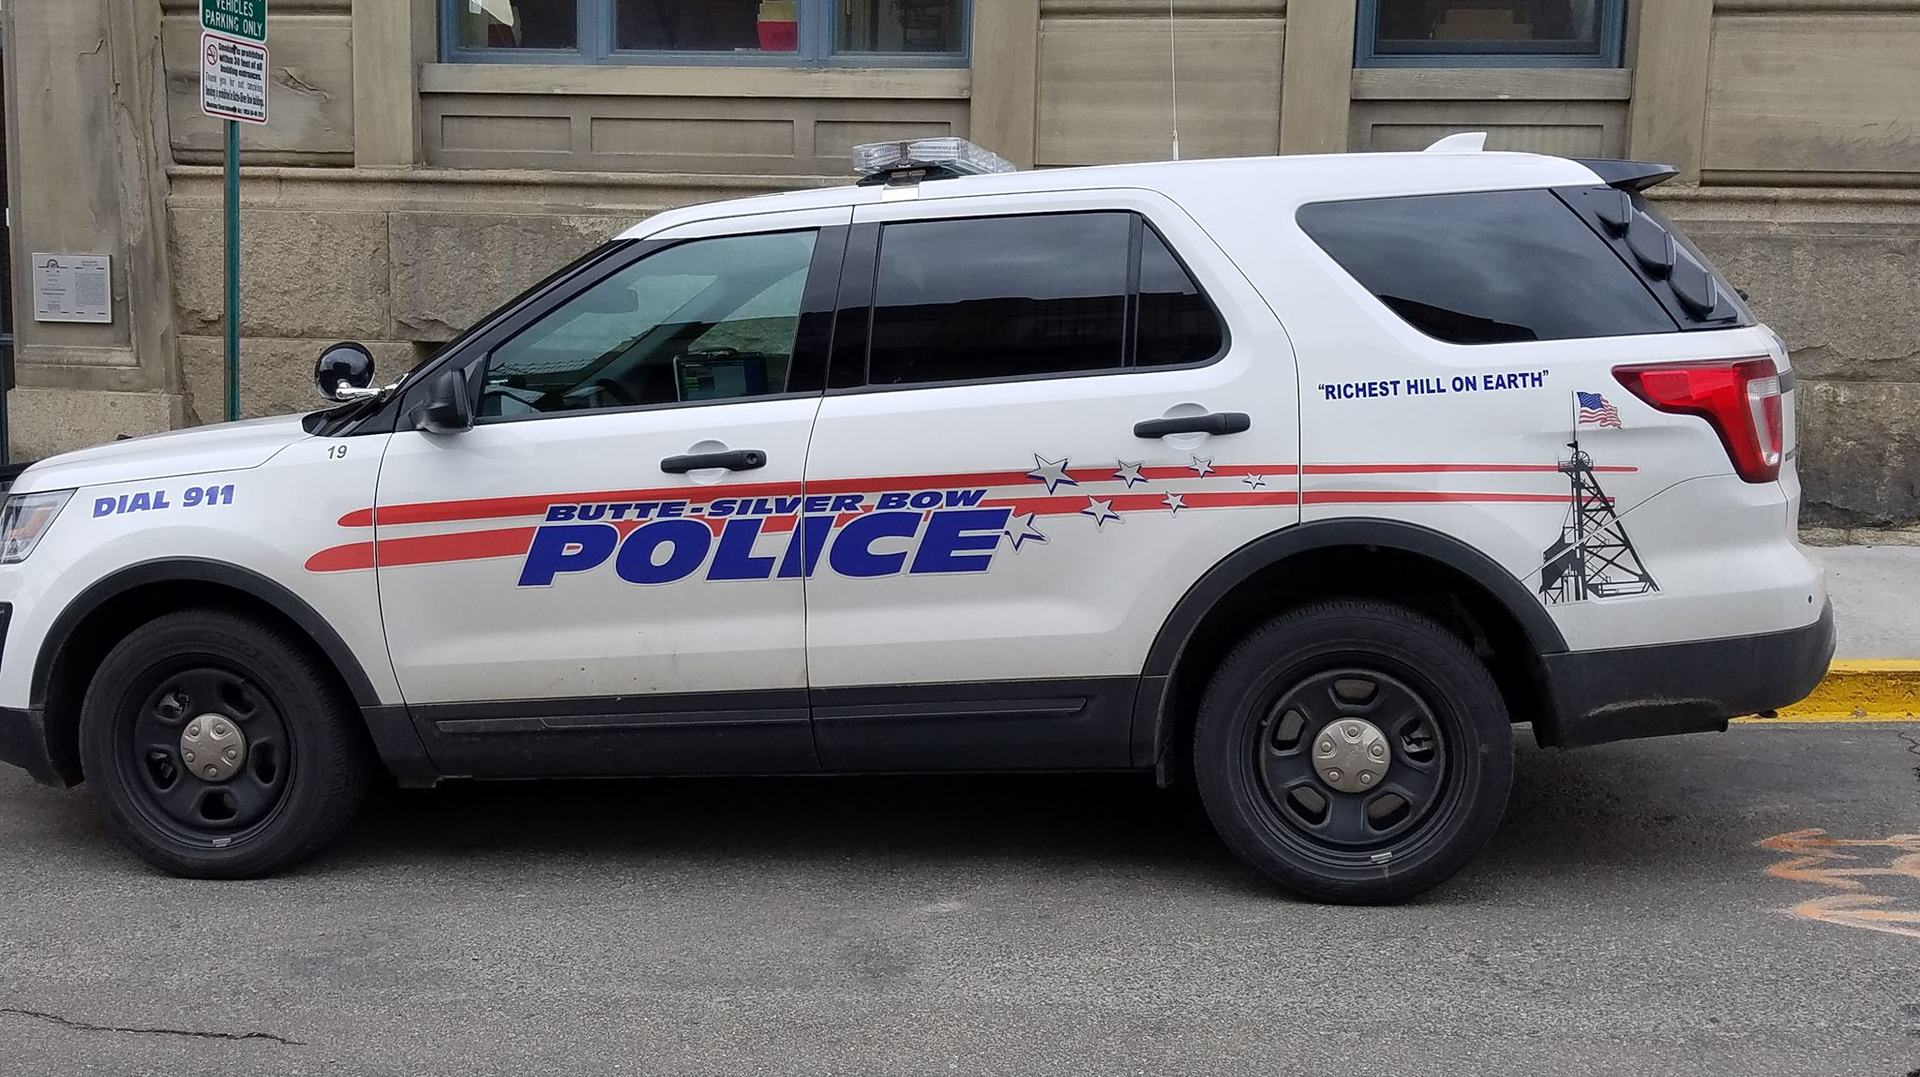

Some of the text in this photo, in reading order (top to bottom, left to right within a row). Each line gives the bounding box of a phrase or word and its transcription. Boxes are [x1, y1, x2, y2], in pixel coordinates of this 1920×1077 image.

[215, 0, 254, 18] VEHICLES
[205, 9, 263, 37] PARKING ONLY
[219, 54, 233, 65] within
[241, 58, 251, 68] feet
[251, 61, 256, 70] of
[241, 49, 264, 61] prohibited
[205, 71, 217, 83] Thank
[219, 77, 227, 86] you
[220, 64, 238, 77] building
[1406, 378, 1447, 395] HILL
[1452, 375, 1477, 392] ON
[327, 444, 348, 460] 19
[92, 484, 235, 518] DIAL 911
[876, 489, 987, 510] BOW
[517, 508, 1012, 587] POLICE
